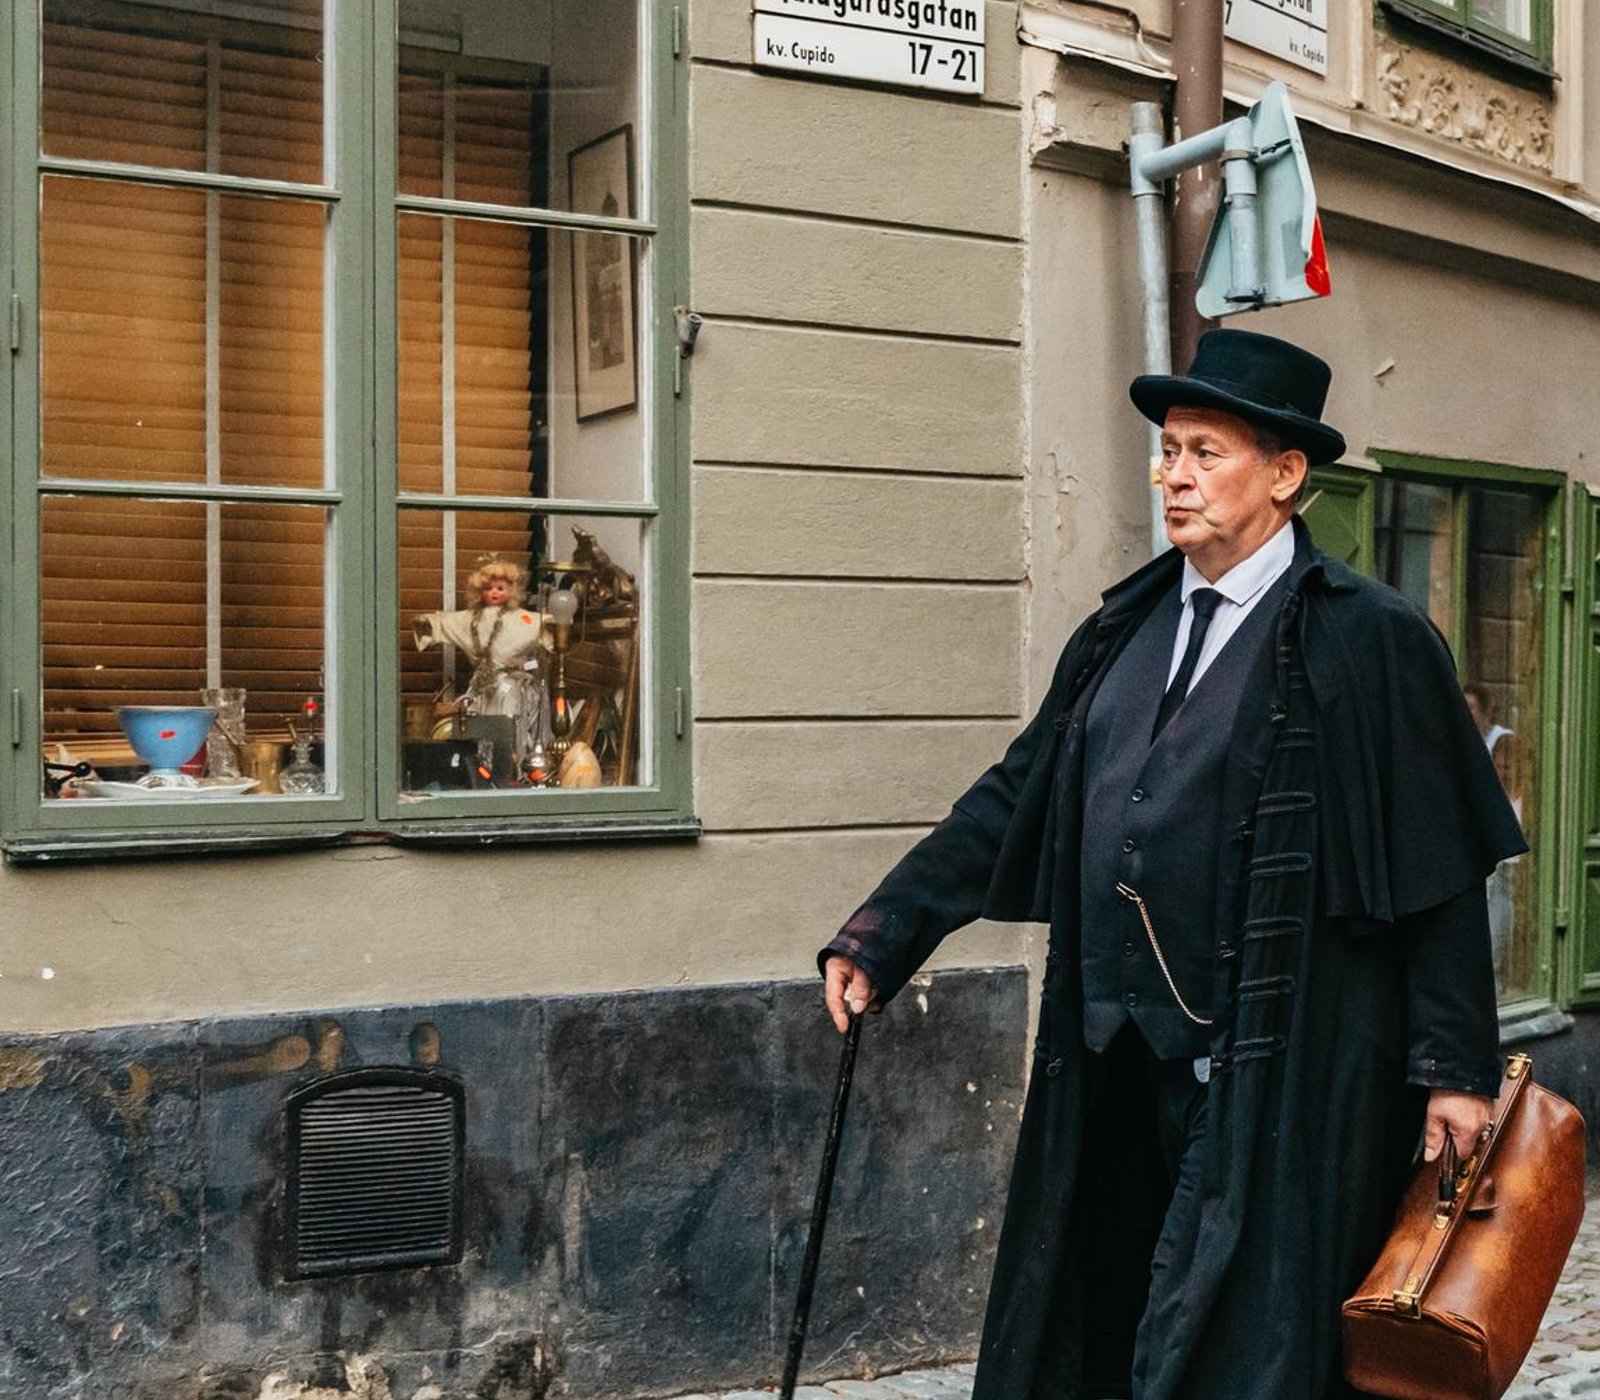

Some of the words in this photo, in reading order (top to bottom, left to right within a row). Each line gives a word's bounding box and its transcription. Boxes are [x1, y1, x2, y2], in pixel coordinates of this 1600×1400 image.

[767, 38, 787, 57] kv.
[792, 42, 835, 65] Cupido
[909, 42, 977, 83] 17-21
